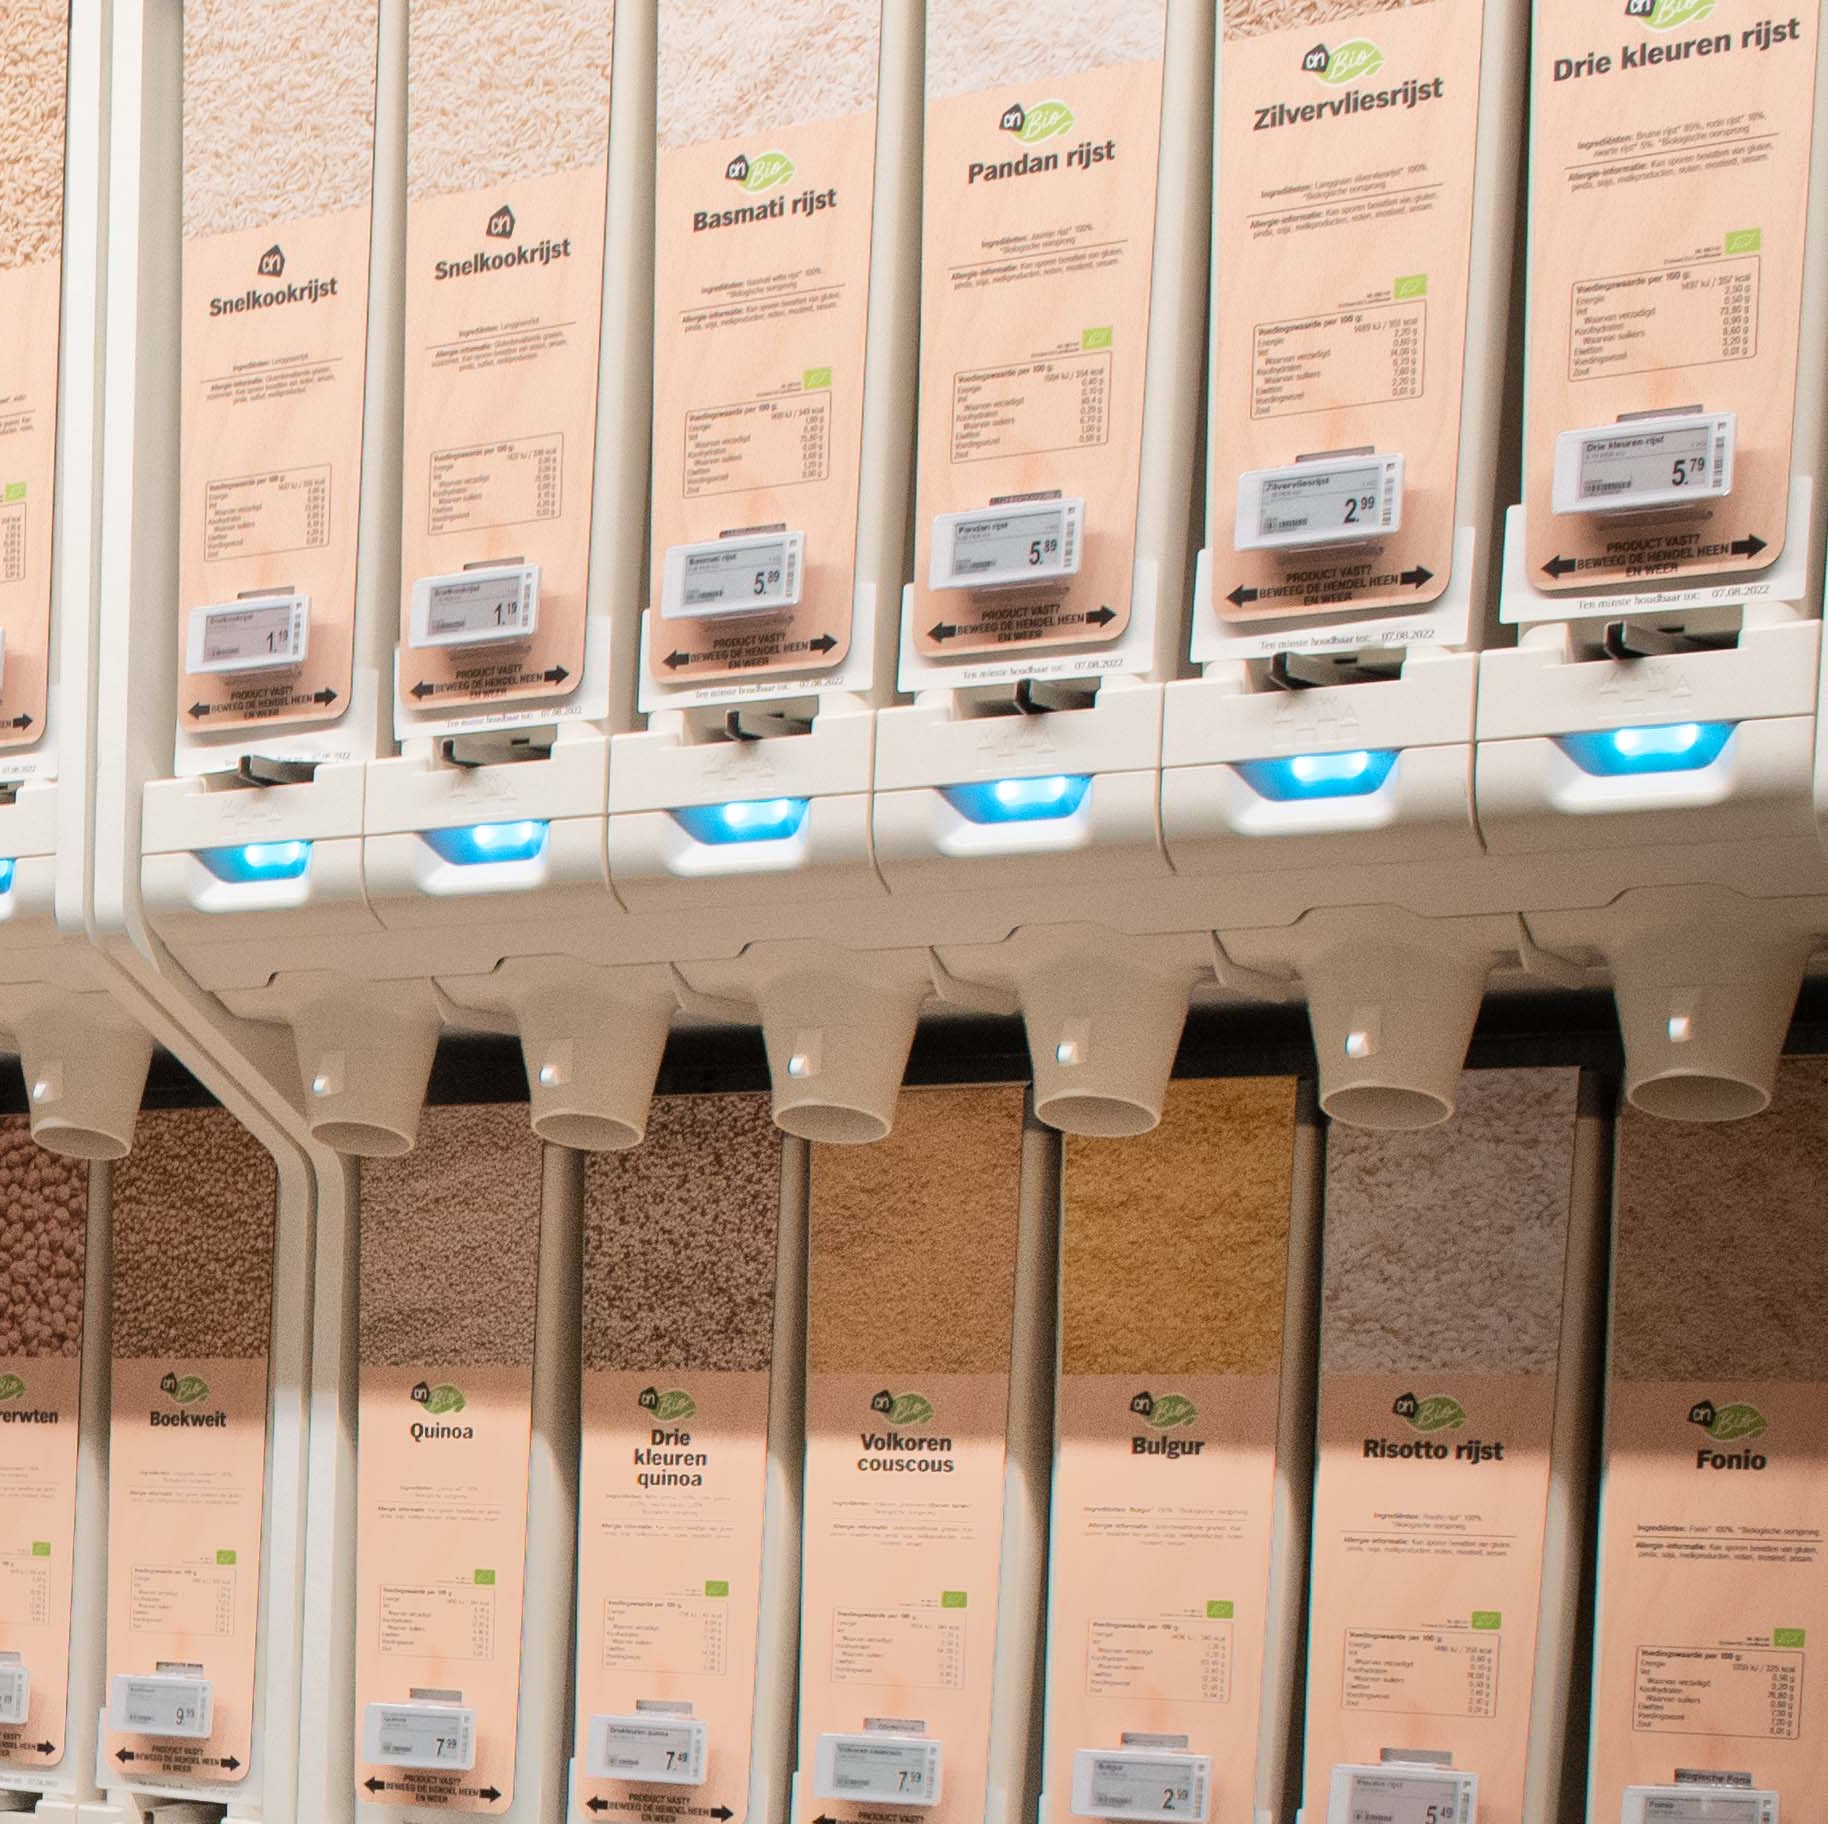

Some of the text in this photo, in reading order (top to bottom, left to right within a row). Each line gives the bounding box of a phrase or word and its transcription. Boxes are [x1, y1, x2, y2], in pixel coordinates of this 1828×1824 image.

[1553, 18, 1800, 81] Drie kleuren rijst
[1253, 77, 1443, 130] Zilvervliesrijst
[968, 139, 1115, 184] Pandan rijst
[692, 187, 837, 234] Basmati rijst
[434, 237, 571, 281] Snelkookrijst
[208, 276, 338, 318] Snelkookrijst
[1607, 534, 1700, 552] PRODUCT VAST?
[1577, 545, 1729, 569] BEWEEG DE HENDEL HEEN
[150, 1411, 226, 1428] Boekweit
[410, 1422, 474, 1442] Quinoa
[651, 1429, 690, 1446] Drie
[861, 1433, 952, 1452] Volkoren
[633, 1449, 707, 1468] kleuren
[1131, 1435, 1205, 1460] Bulgur
[1363, 1439, 1504, 1463] Risotto rijst
[1696, 1448, 1767, 1470] Fonio
[857, 1456, 955, 1474] couscous
[637, 1469, 703, 1489] quinoa
